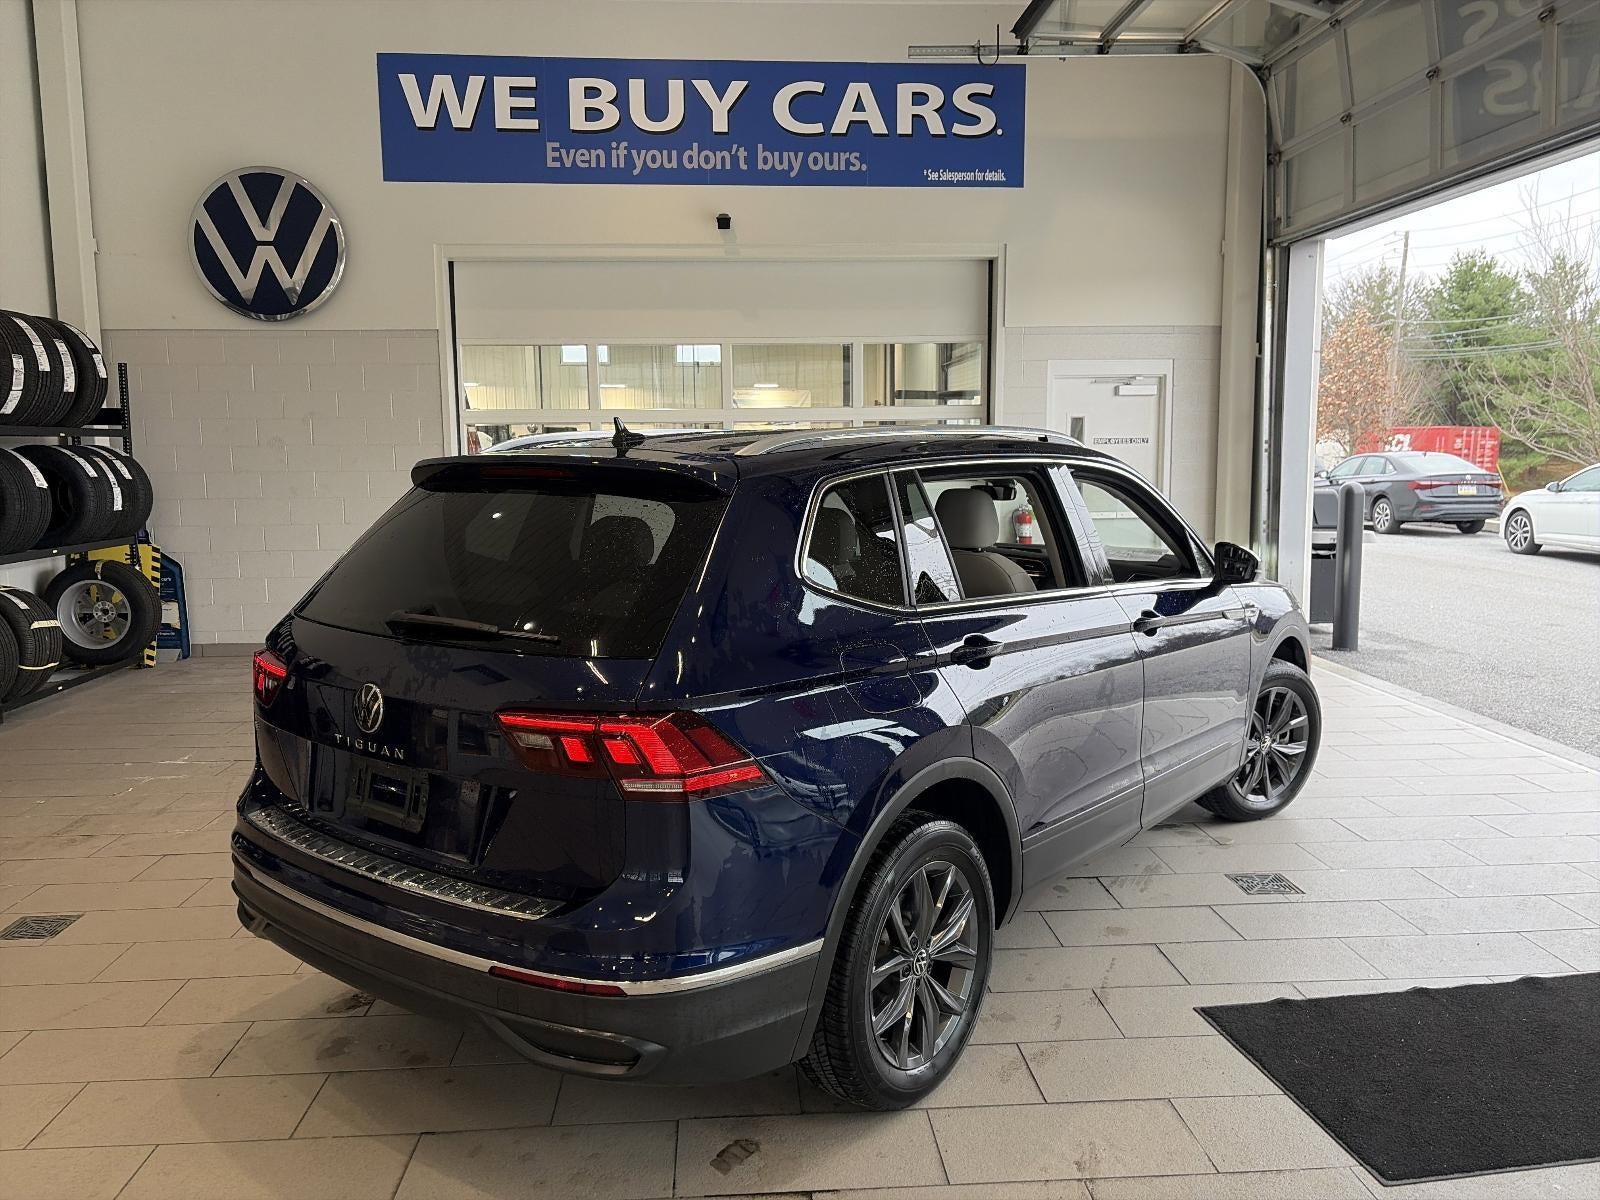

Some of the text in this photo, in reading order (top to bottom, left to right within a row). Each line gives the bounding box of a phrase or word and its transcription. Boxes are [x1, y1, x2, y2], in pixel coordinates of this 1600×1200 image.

[398, 73, 1003, 138] WE BUY CARS.
[546, 141, 867, 178] Even if you don't buy ours.
[939, 168, 974, 184] Salesperson
[975, 168, 984, 181] for
[984, 169, 1006, 182] details.
[334, 733, 404, 760] TIGUAN
